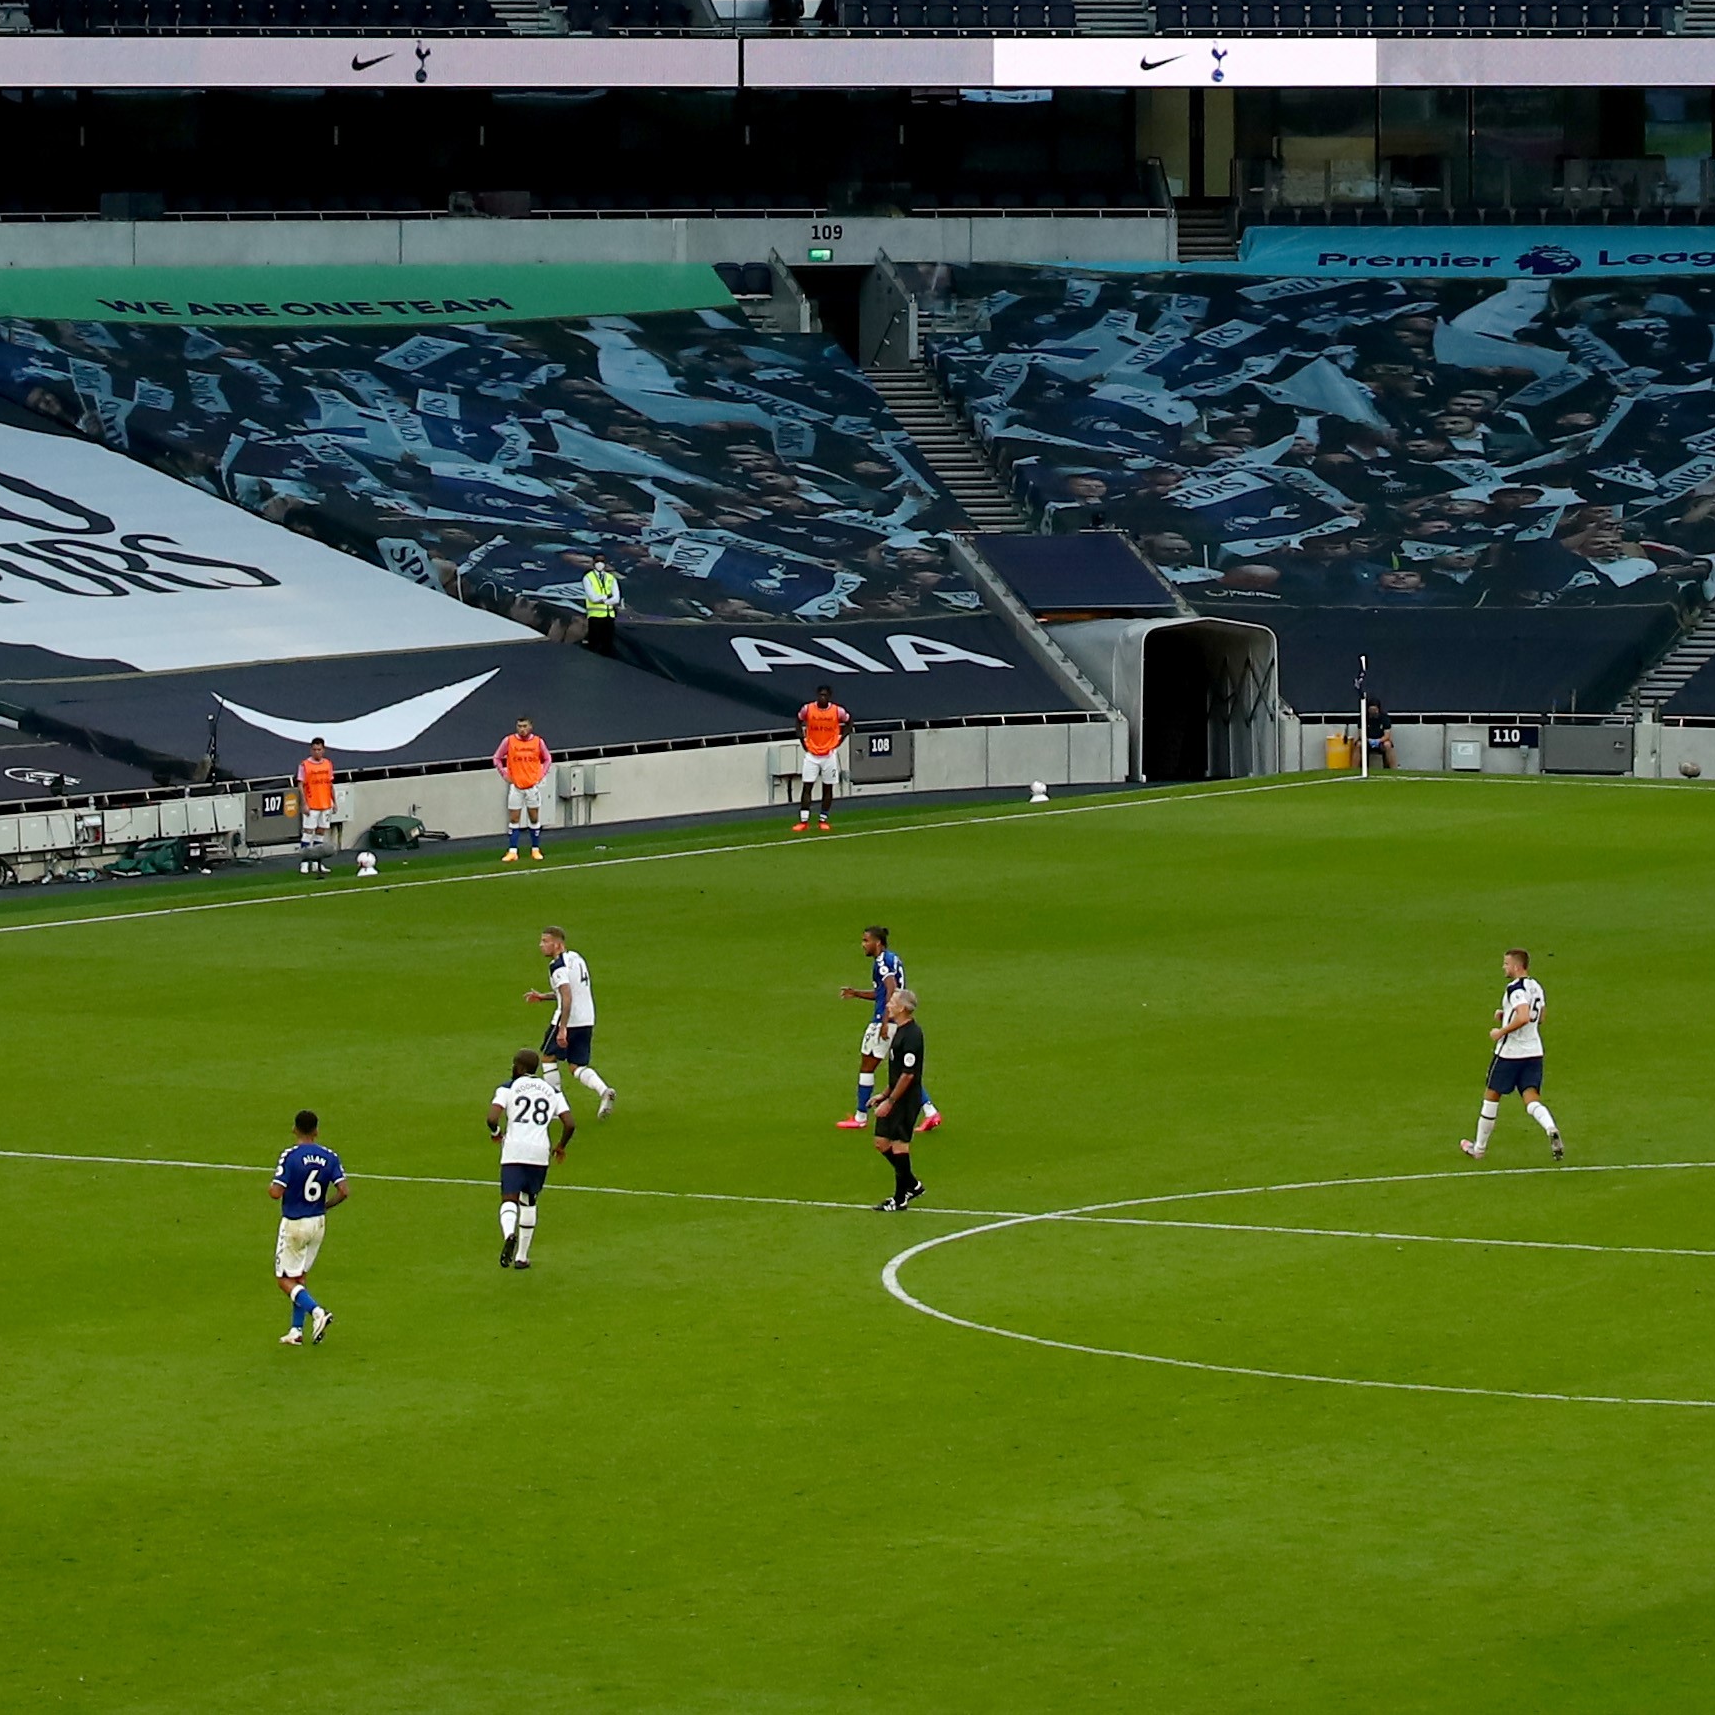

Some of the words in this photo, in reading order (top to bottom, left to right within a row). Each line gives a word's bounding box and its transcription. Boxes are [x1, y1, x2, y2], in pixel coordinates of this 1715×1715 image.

[811, 225, 843, 240] 109
[1317, 251, 1500, 269] Premier
[96, 297, 182, 315] WE
[186, 301, 279, 317] ARE
[280, 300, 383, 317] ONE
[379, 297, 514, 315] TEAM
[730, 634, 1015, 673] AIA
[871, 737, 890, 753] 108
[1492, 729, 1521, 744] 110
[264, 796, 283, 812] 107
[514, 1095, 550, 1126] 28
[303, 1154, 327, 1167] ALLAN
[304, 1169, 322, 1203] 6
